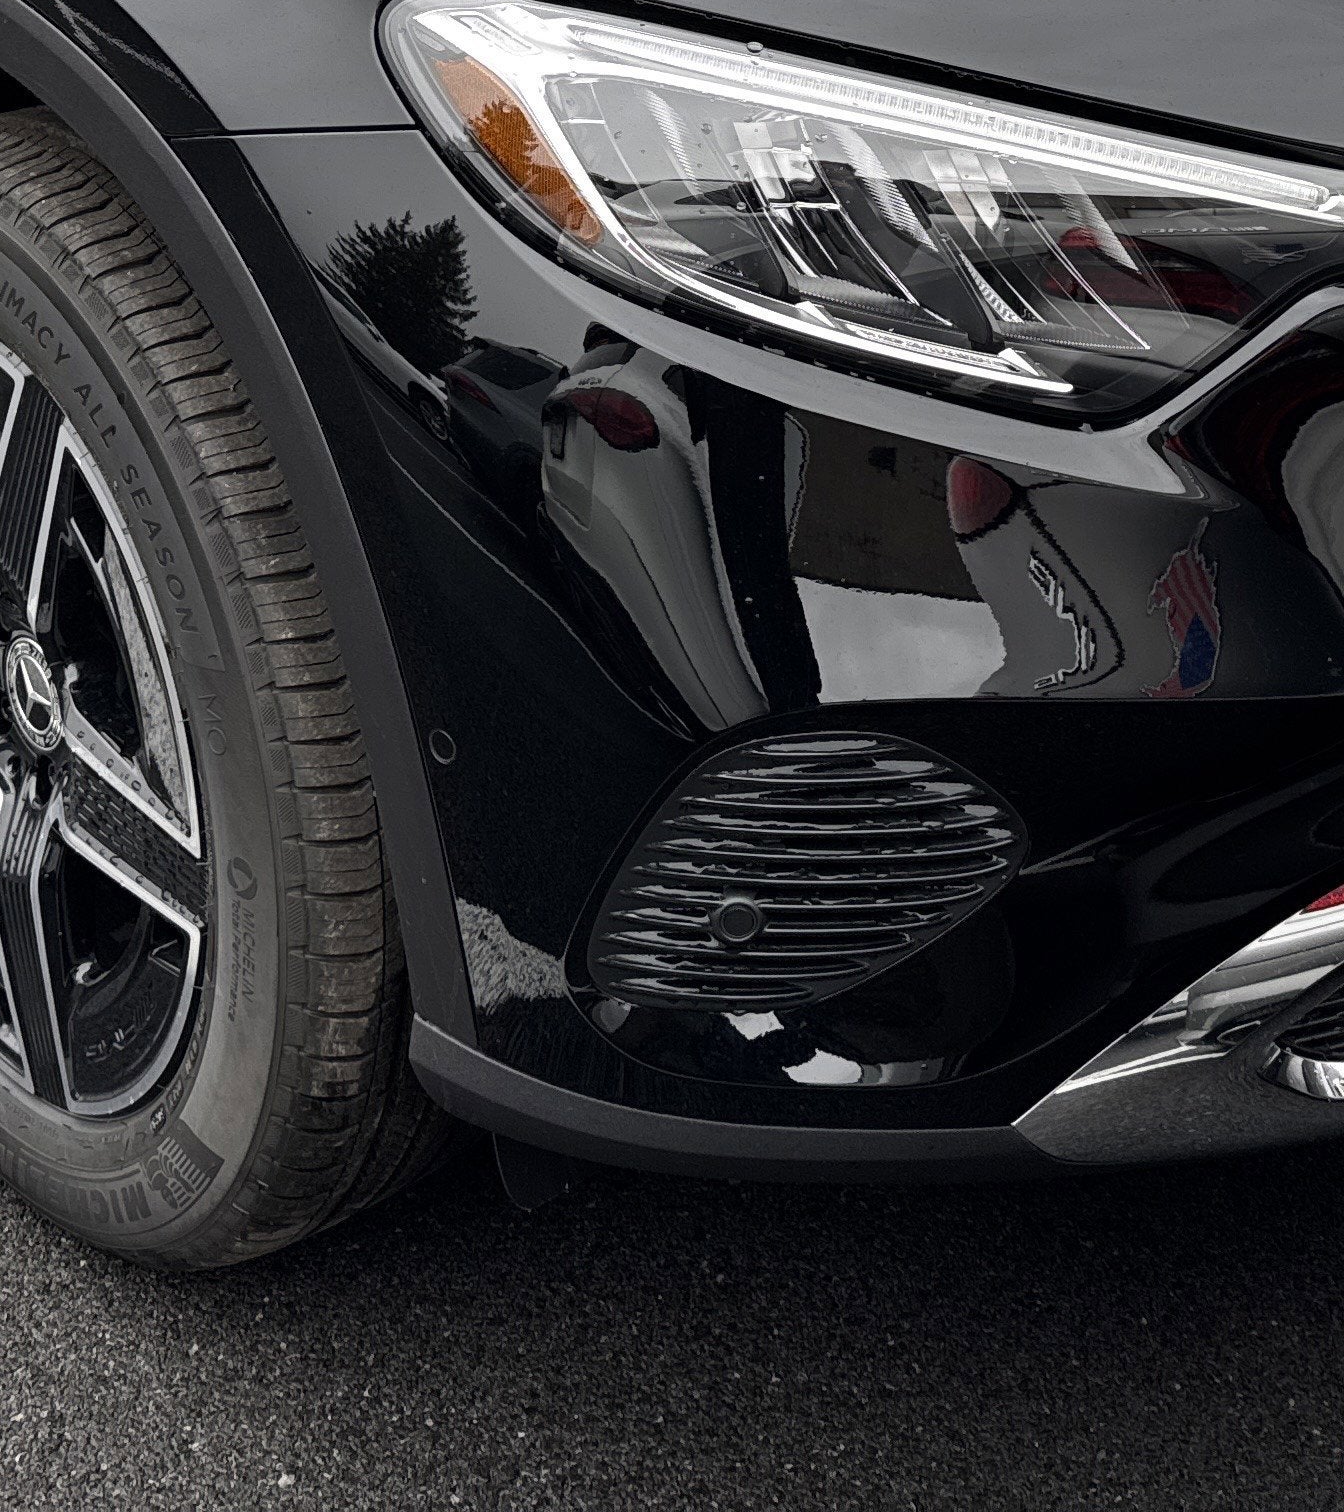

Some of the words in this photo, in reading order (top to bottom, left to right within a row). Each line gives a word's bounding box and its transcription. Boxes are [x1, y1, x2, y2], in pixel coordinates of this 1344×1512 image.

[73, 382, 116, 450] ALL
[120, 461, 196, 635] SEASON
[242, 907, 256, 1003] MICHELIN
